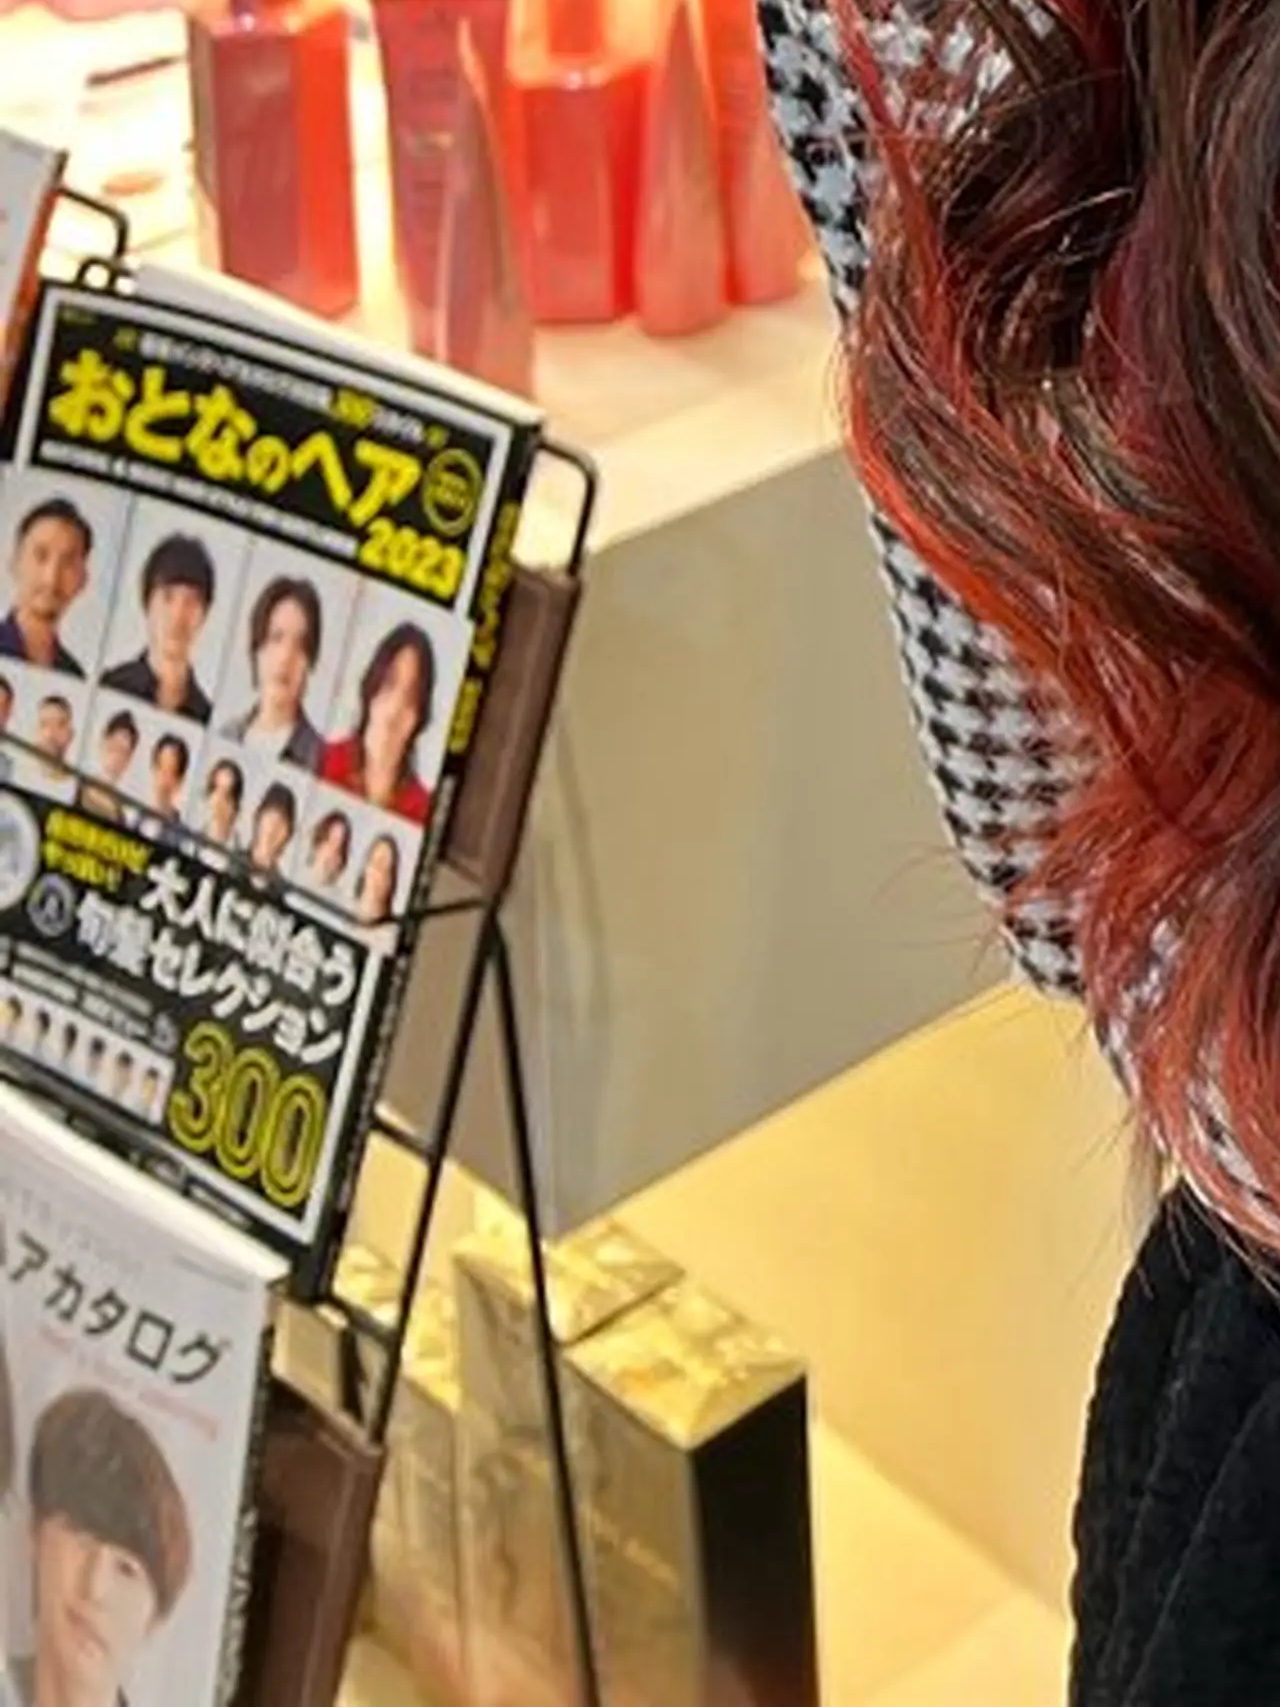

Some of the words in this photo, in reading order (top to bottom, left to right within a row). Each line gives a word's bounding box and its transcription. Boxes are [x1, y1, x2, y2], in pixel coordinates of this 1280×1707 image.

[48, 349, 421, 525] おとなのヘア
[168, 1019, 329, 1209] 300
[0, 1217, 232, 1385] アカタログ
